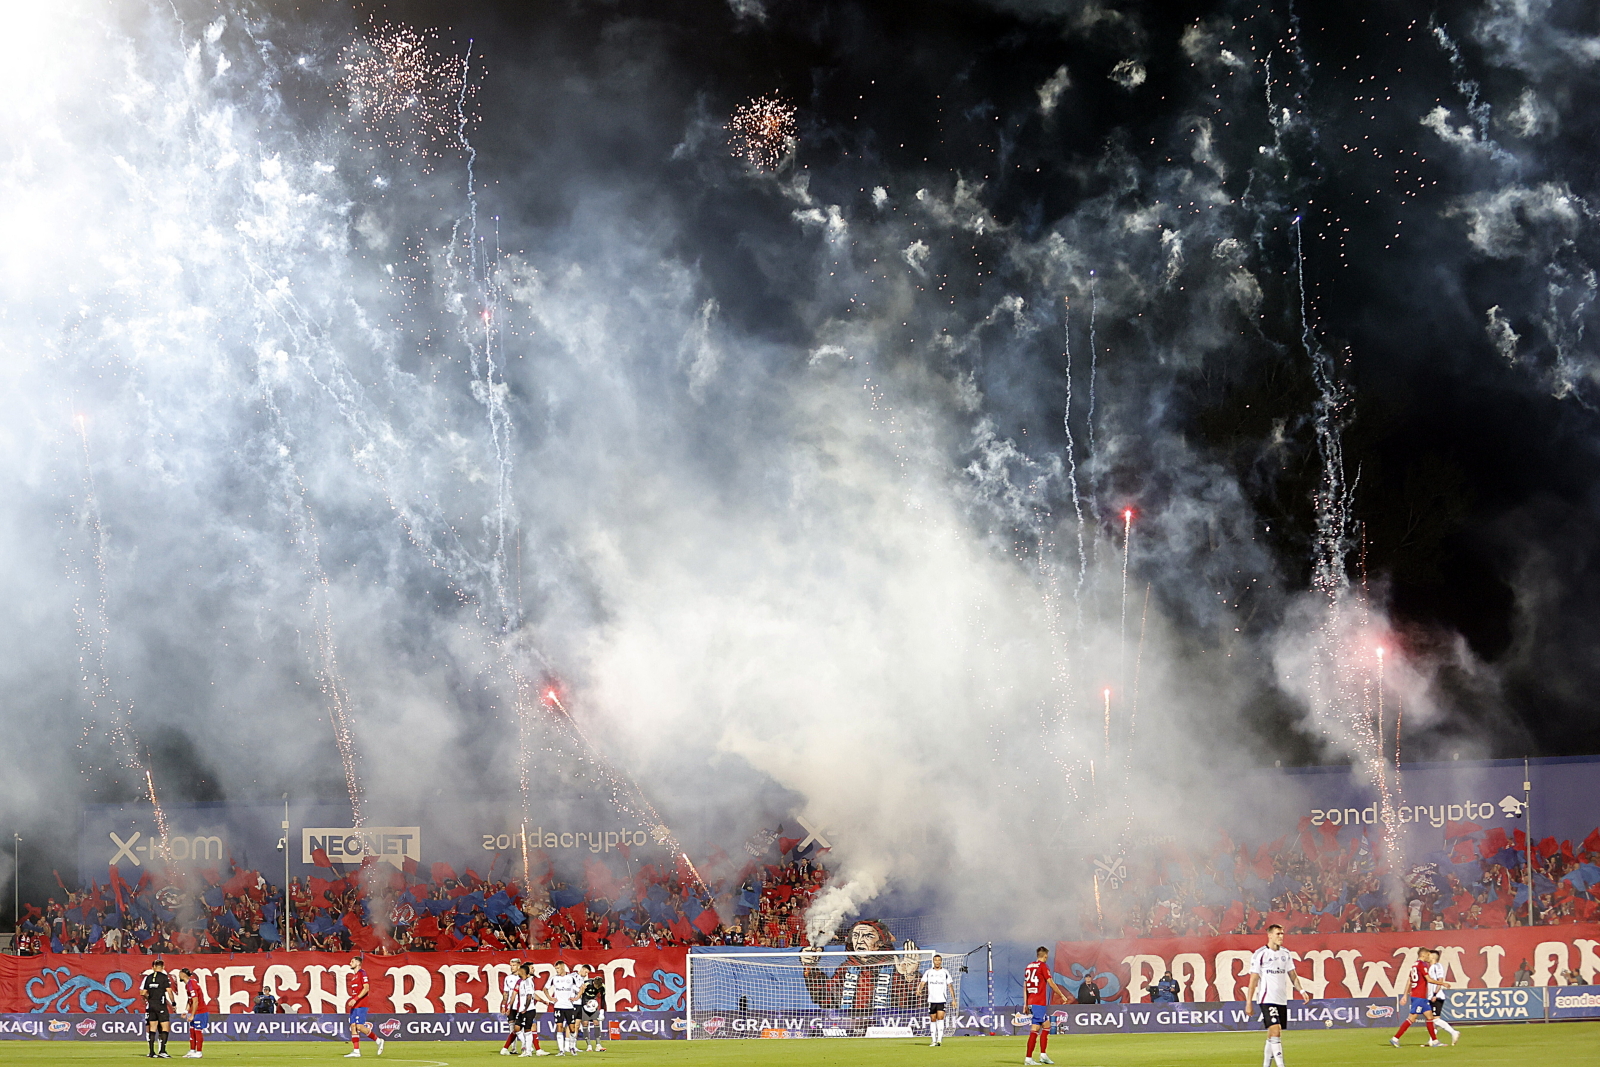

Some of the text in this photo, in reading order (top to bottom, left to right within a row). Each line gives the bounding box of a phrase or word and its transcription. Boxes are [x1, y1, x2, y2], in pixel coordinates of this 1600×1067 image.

[1310, 800, 1495, 828] zondacrypto
[309, 834, 413, 856] NEONET
[482, 826, 647, 853] zondacrypto
[1024, 969, 1040, 987] 24
[783, 1018, 804, 1030] W
[907, 1014, 1005, 1030] APIKACJI
[1075, 1012, 1124, 1028] GRAJ
[1130, 1011, 1151, 1025] W
[1156, 1010, 1224, 1025] GIERKI
[1257, 1006, 1361, 1023] LIKACJI
[101, 1021, 144, 1036] GRAJ
[234, 1021, 252, 1034] W
[255, 1021, 344, 1036] APLIKACJI
[406, 1021, 451, 1036] GRAJ
[456, 1021, 476, 1034] W
[480, 1020, 541, 1034] GIEI
